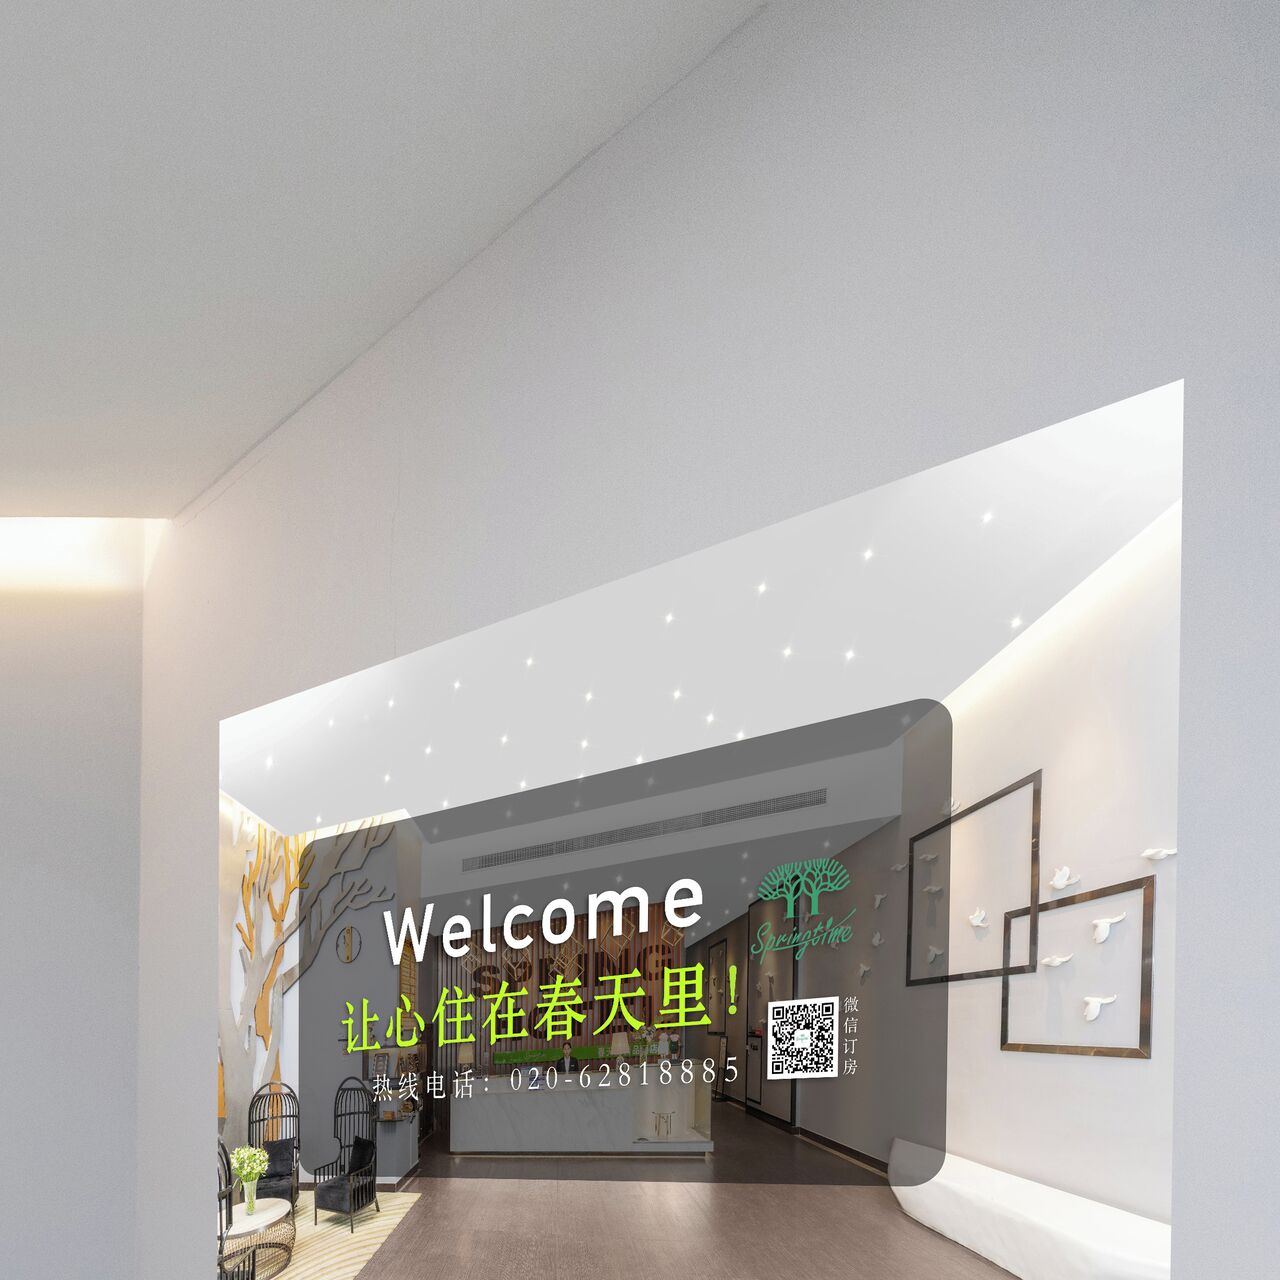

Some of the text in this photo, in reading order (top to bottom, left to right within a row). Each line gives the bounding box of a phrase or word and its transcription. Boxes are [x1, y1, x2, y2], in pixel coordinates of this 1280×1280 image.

[383, 878, 703, 966] Welcome
[750, 907, 857, 966] Springtime
[341, 963, 738, 1054] 让心住在春天里！
[843, 996, 860, 1076] 微信订房
